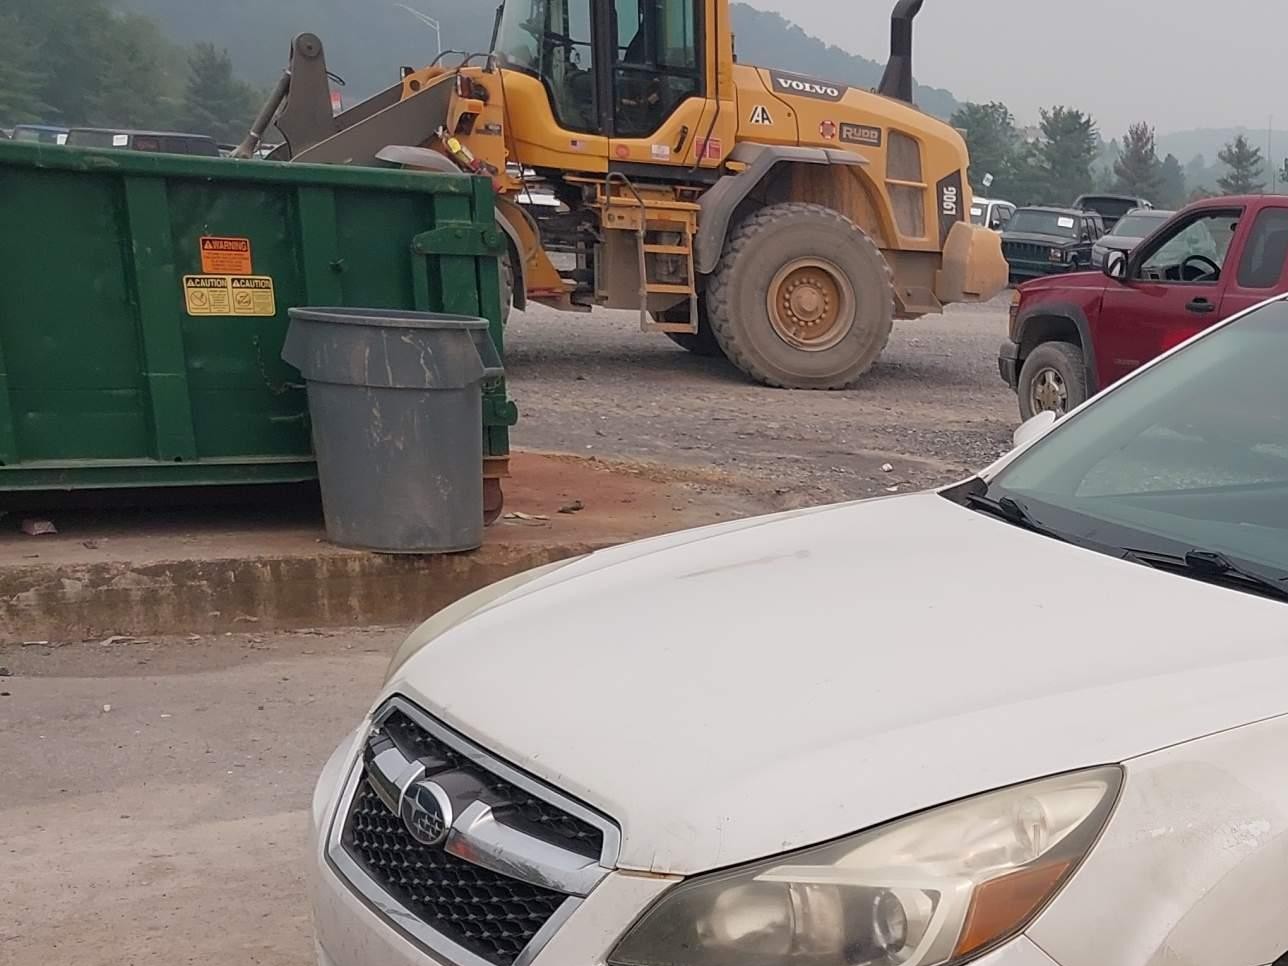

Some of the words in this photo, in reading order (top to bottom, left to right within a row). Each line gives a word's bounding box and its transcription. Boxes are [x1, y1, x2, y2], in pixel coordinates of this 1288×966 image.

[777, 77, 839, 97] VOLVO
[842, 126, 879, 139] RUDD
[943, 187, 957, 215] L90G
[211, 240, 247, 251] WARNING
[194, 279, 227, 287] CAUTION
[240, 280, 271, 288] CAUTION
